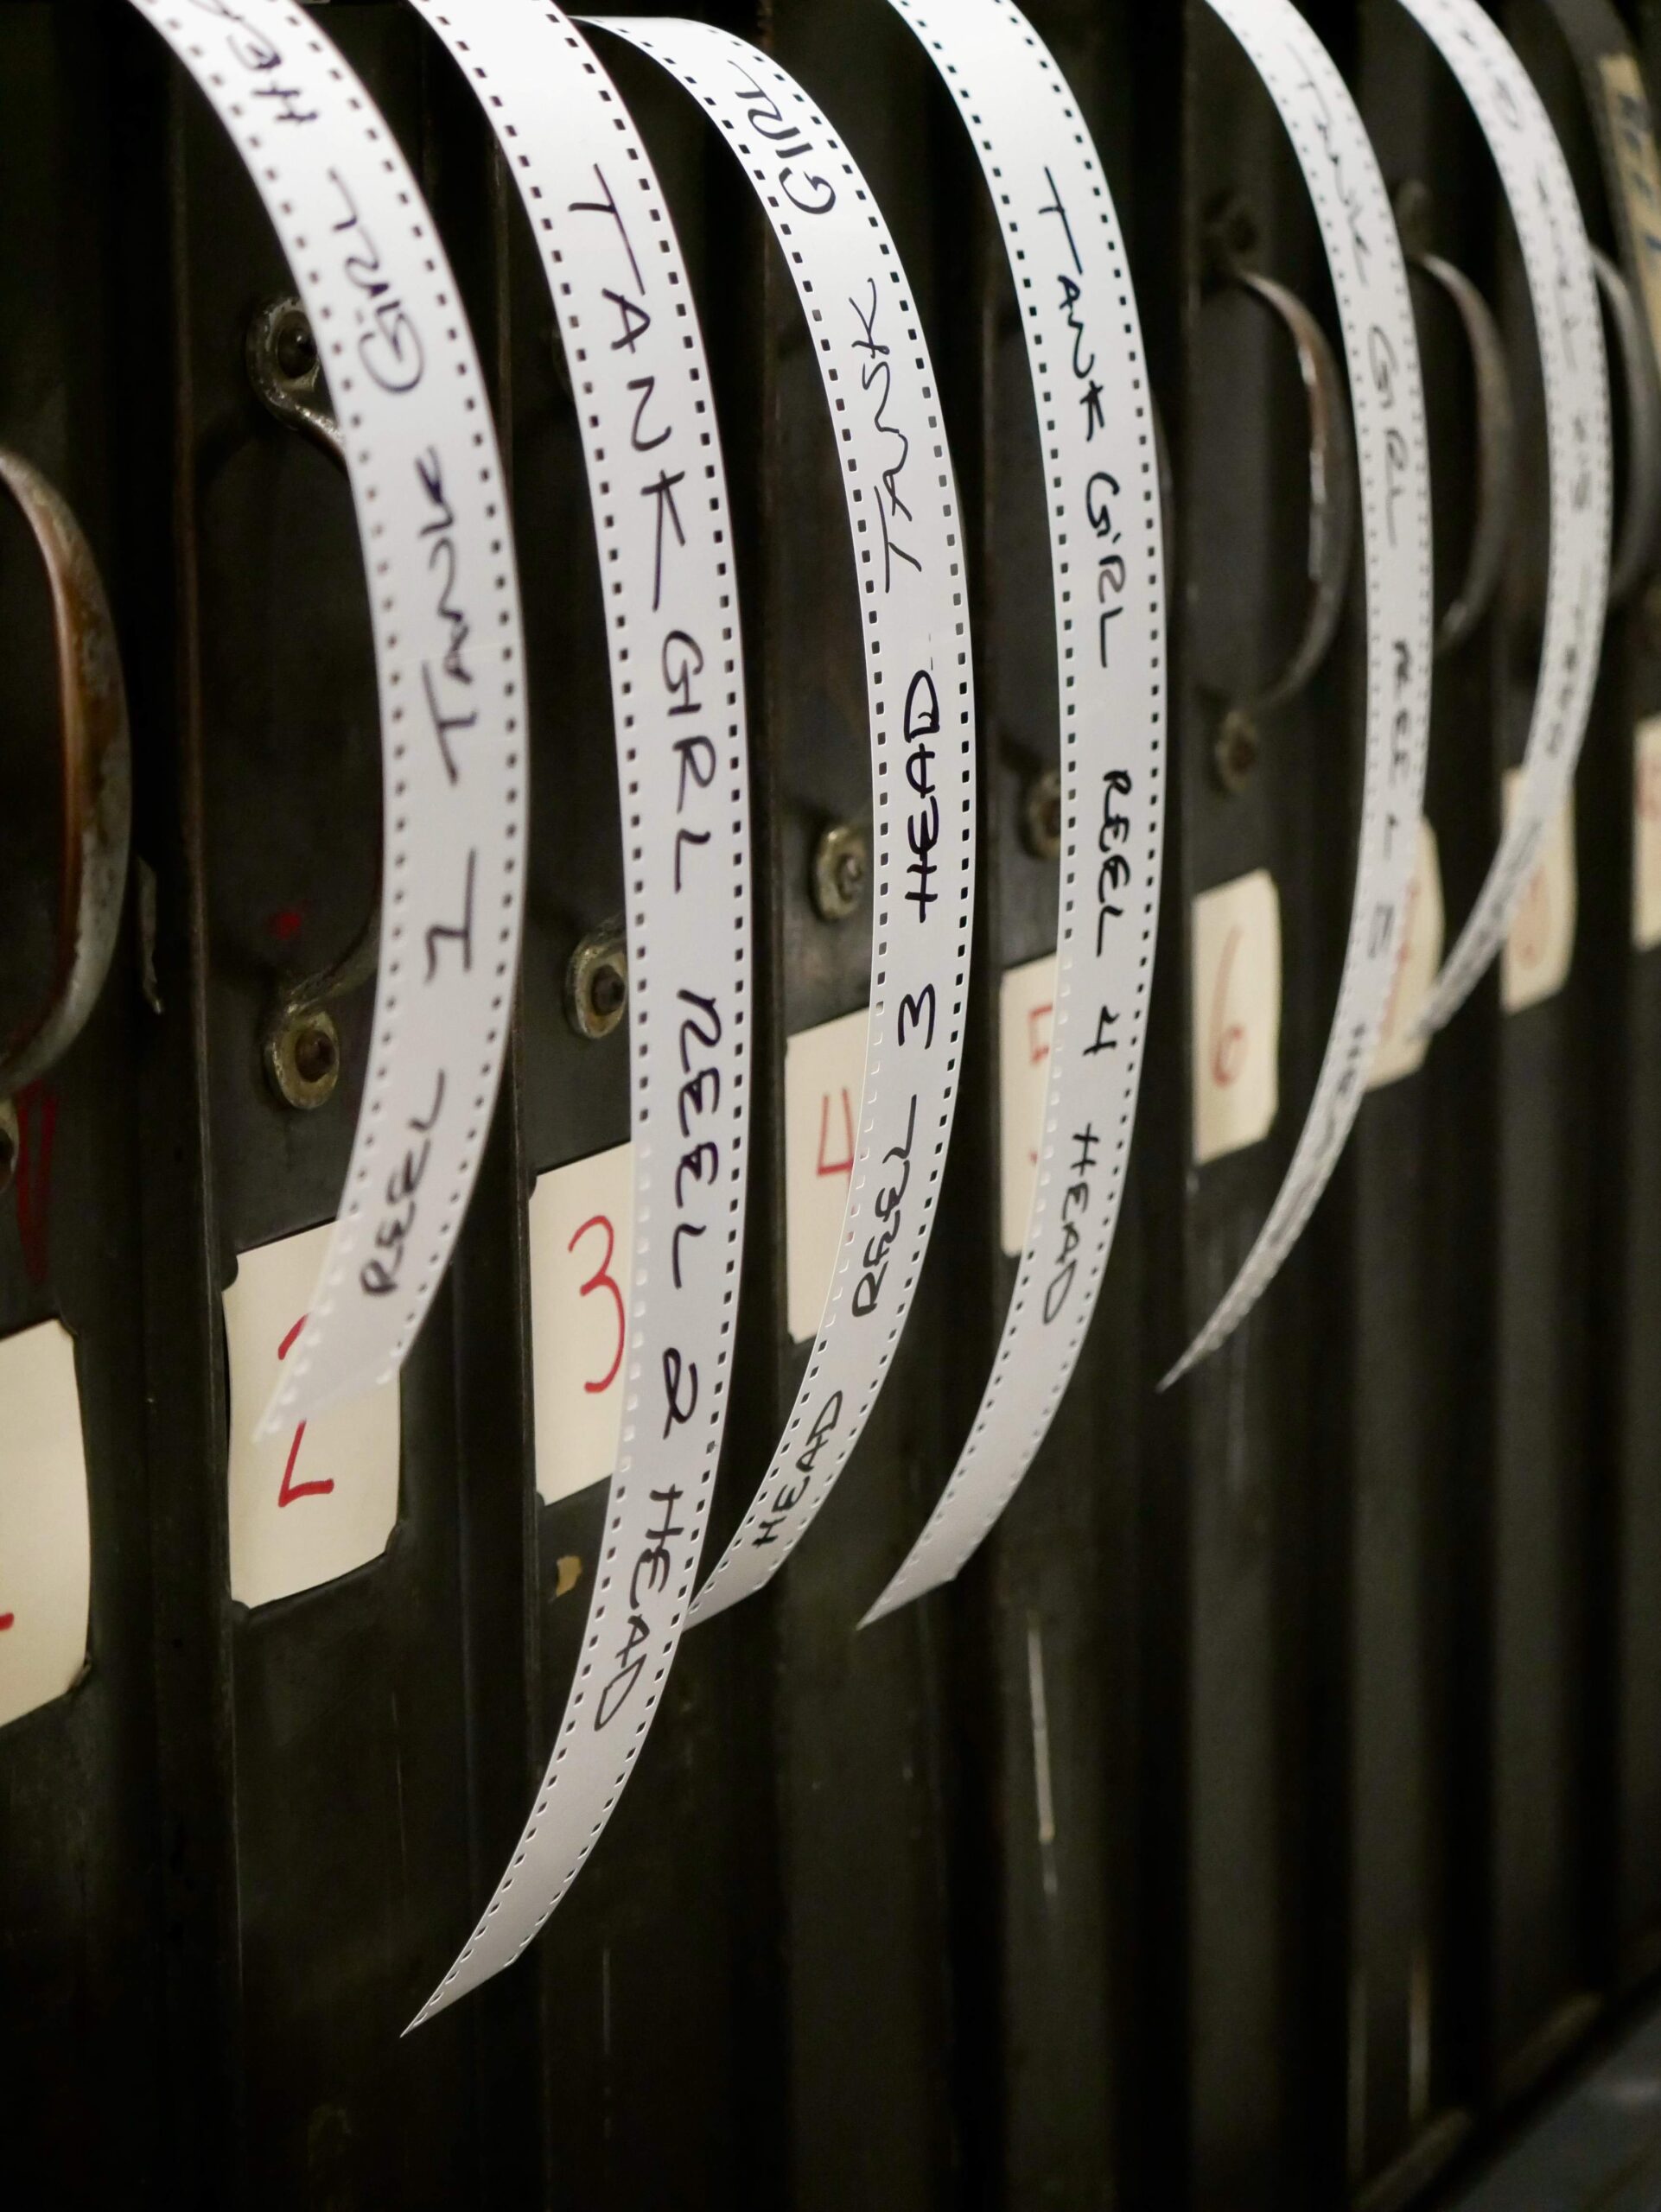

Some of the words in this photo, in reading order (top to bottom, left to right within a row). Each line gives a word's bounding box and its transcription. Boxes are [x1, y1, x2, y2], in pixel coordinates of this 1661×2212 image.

[728, 59, 837, 215] GIRL
[328, 167, 424, 394] GIRL
[569, 164, 685, 612] TANK
[1039, 167, 1106, 442] TANK
[850, 277, 922, 594] TANK
[416, 447, 478, 786] TANK
[1085, 472, 1127, 669] GIRL
[662, 629, 717, 893] GIRL
[904, 670, 940, 924] HEAD
[1094, 770, 1133, 957] REEL
[425, 849, 476, 982] 1
[899, 983, 937, 1050] 3
[671, 987, 722, 1289] REEL
[1082, 1005, 1120, 1056] 4
[360, 1069, 445, 1297] REEL
[852, 1094, 918, 1318] REEL
[1042, 1122, 1100, 1325] HEAD
[567, 1214, 626, 1394] 3
[662, 1347, 698, 1439] 2
[753, 1390, 843, 1548] HEAD
[594, 1484, 684, 1732] HEAD
